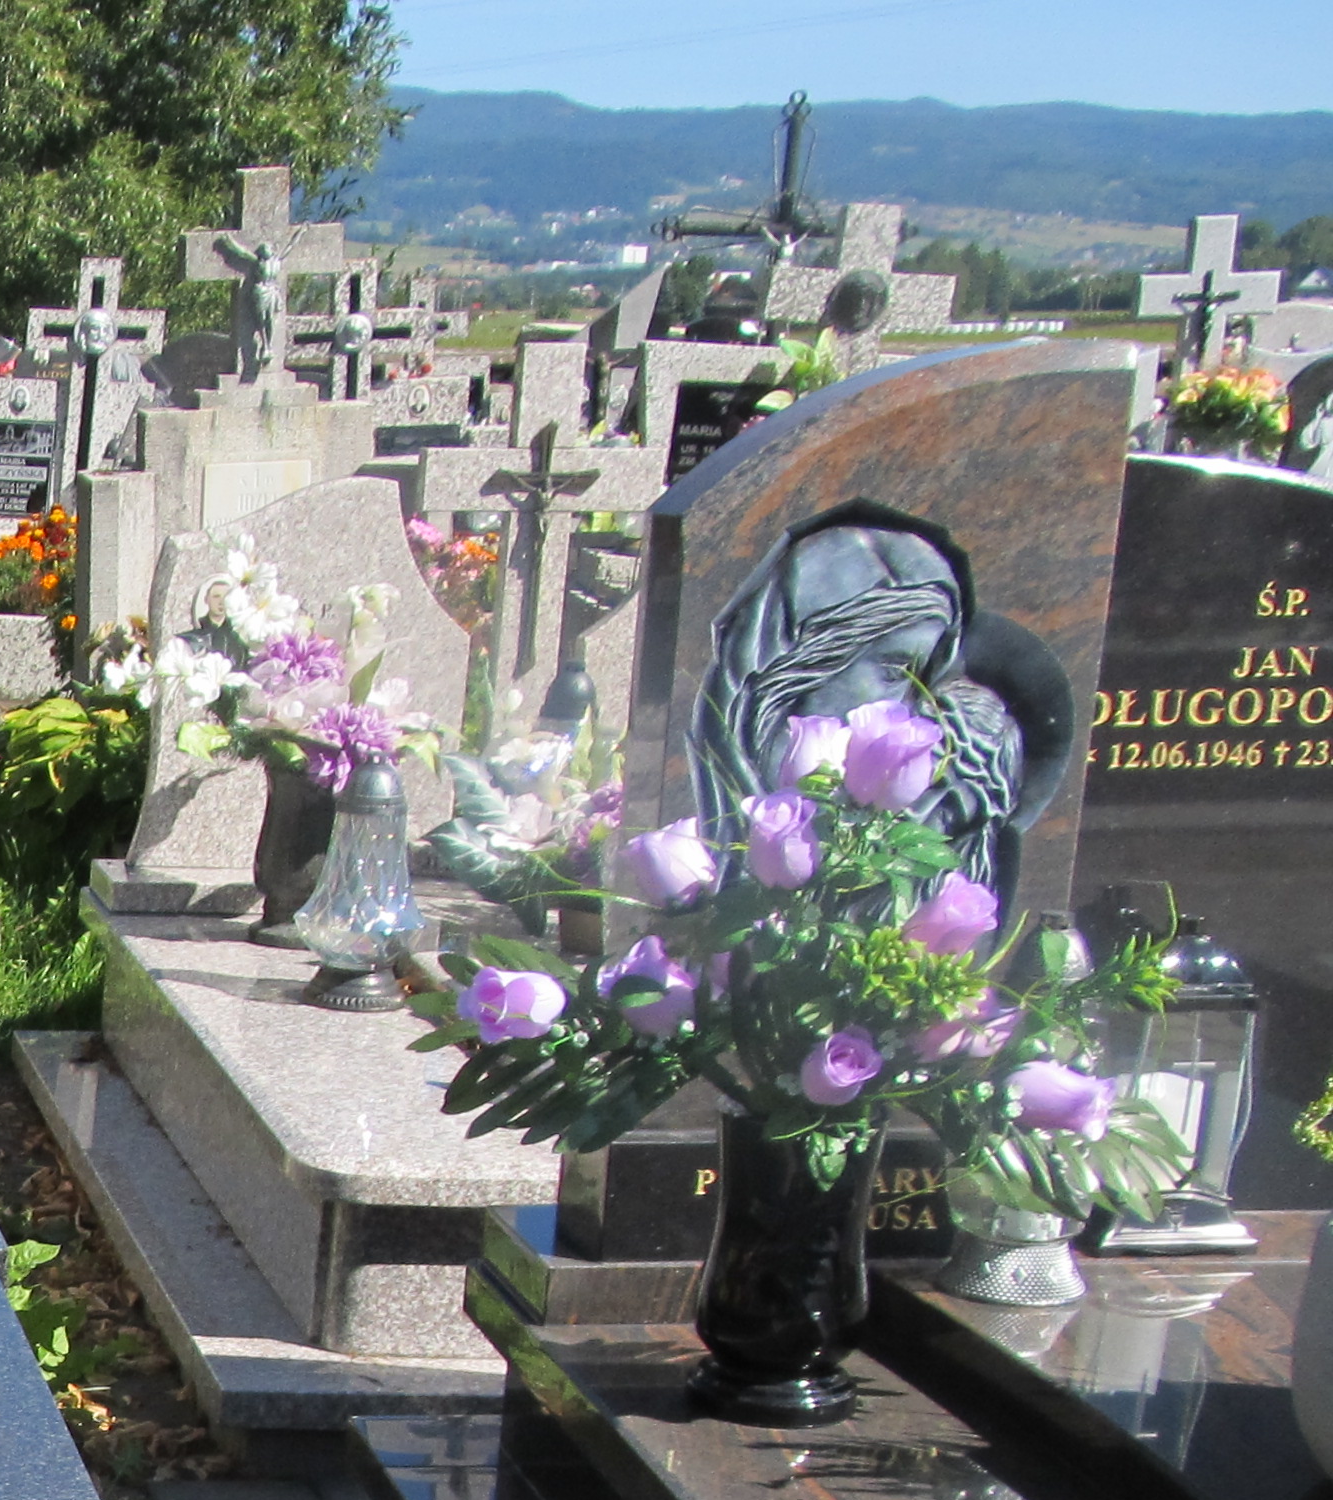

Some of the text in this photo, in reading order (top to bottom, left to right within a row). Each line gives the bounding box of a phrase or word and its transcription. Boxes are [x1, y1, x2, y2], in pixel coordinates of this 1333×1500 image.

[1256, 578, 1311, 617] Ś.P.
[1233, 645, 1320, 679] JAN
[1108, 739, 1264, 769] 12.06.1946
